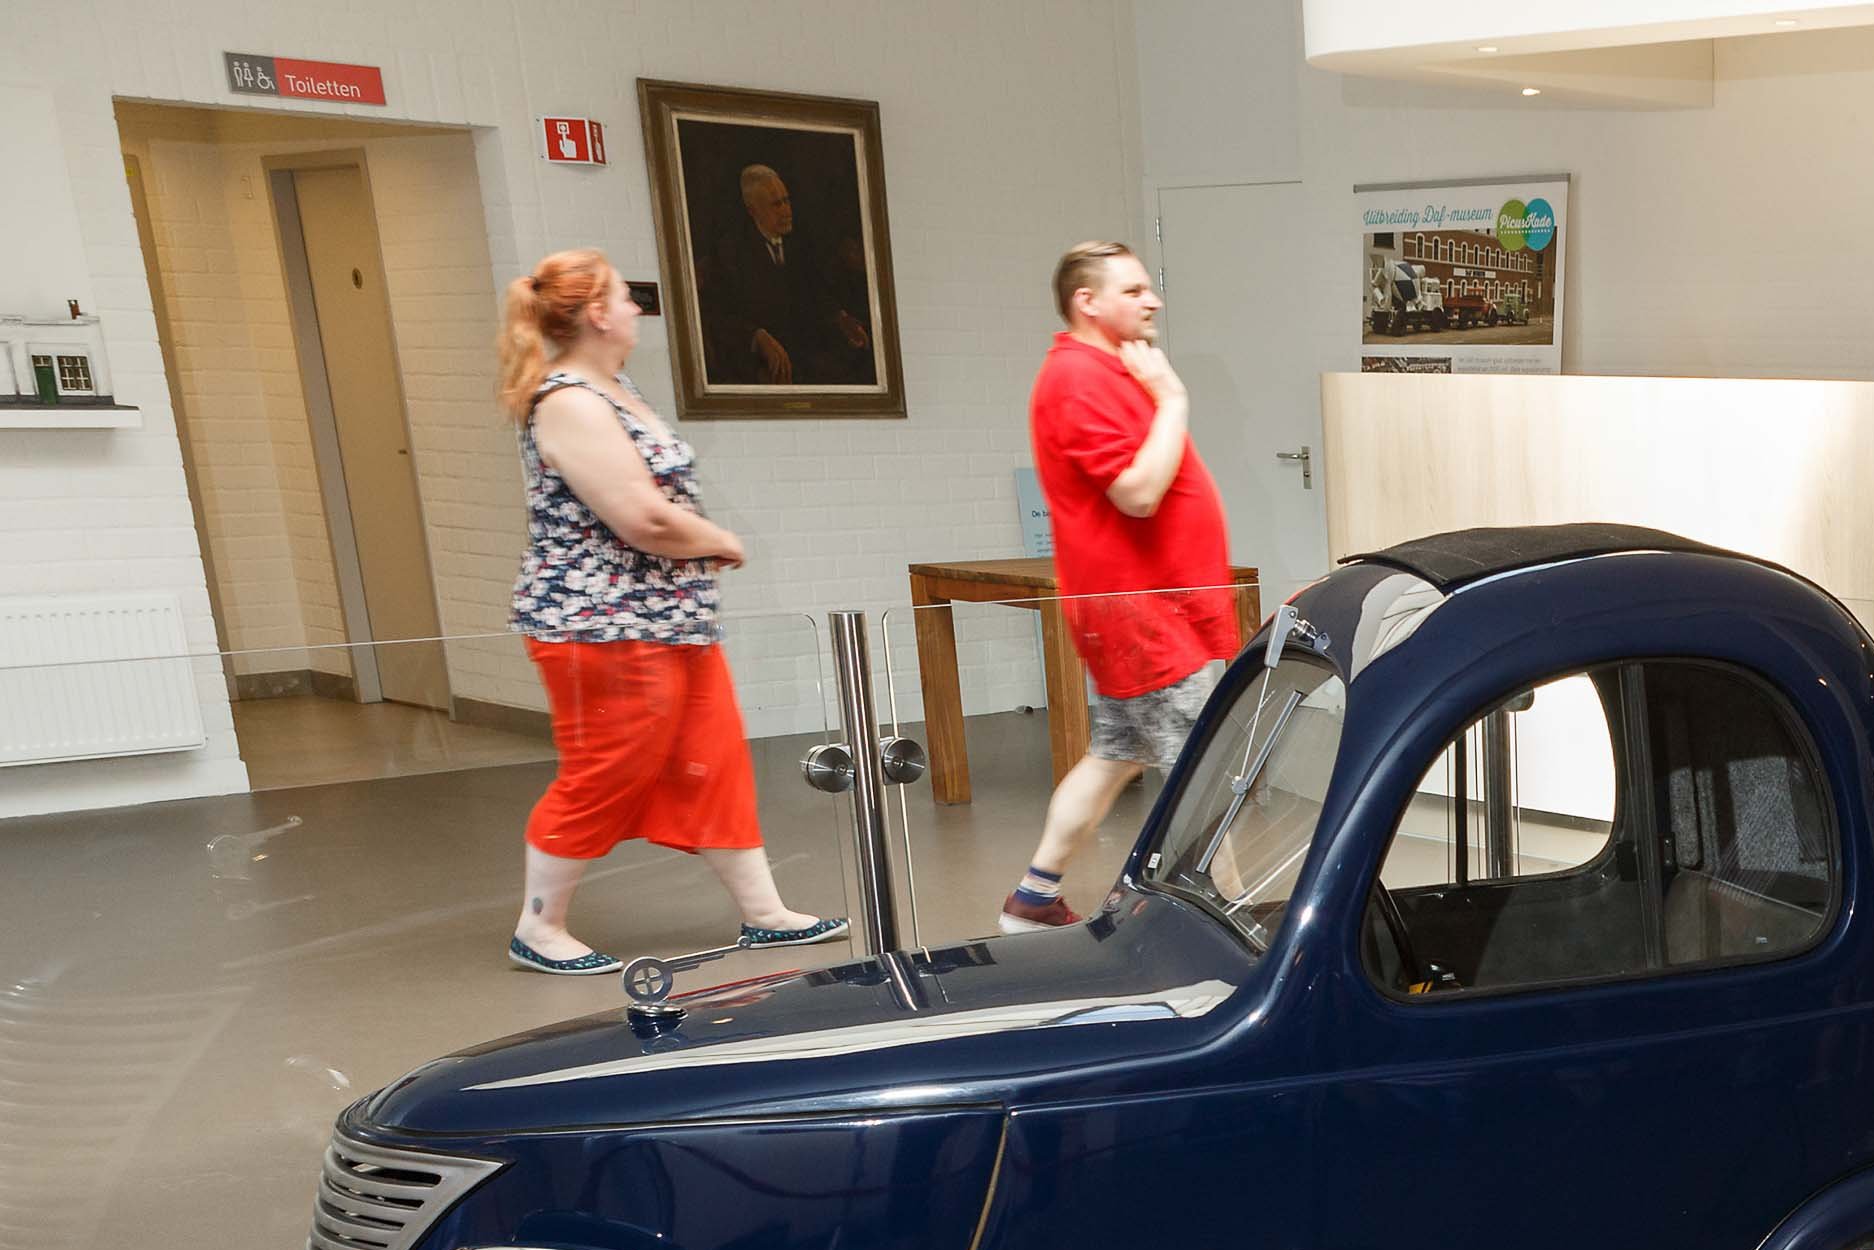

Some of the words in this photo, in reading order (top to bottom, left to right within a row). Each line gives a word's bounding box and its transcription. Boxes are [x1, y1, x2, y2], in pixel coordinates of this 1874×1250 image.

[284, 74, 361, 98] Toiletten
[1362, 207, 1419, 229] Uitbreiding
[1421, 205, 1492, 228] Daf-museum
